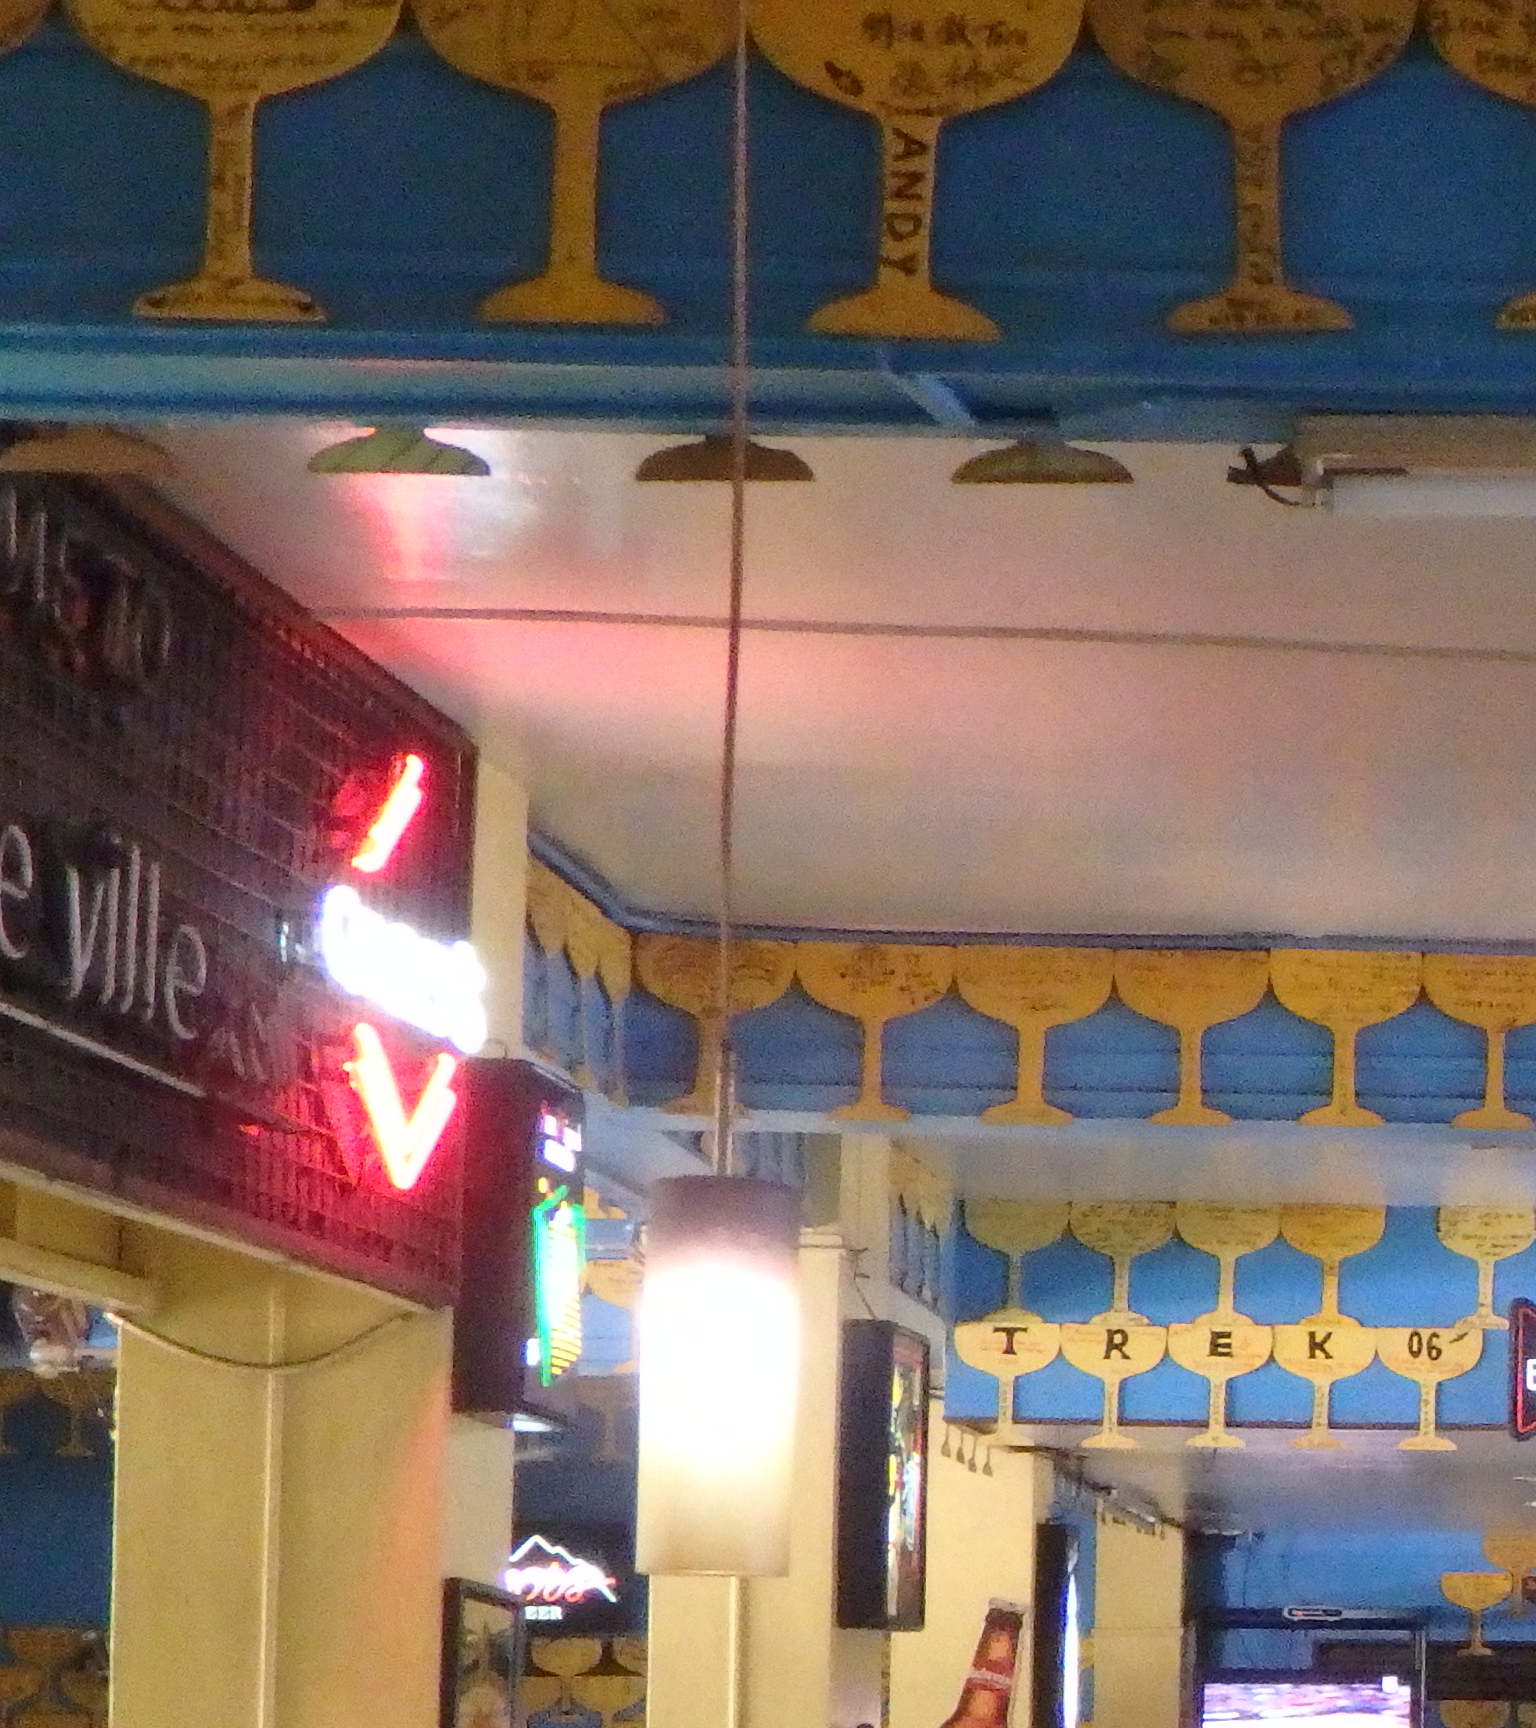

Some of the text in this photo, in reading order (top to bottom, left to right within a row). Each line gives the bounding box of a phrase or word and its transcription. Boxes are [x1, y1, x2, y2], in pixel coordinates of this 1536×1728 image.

[879, 127, 926, 276] ANDY
[66, 841, 207, 1040] ville
[524, 1605, 563, 1620] EER
